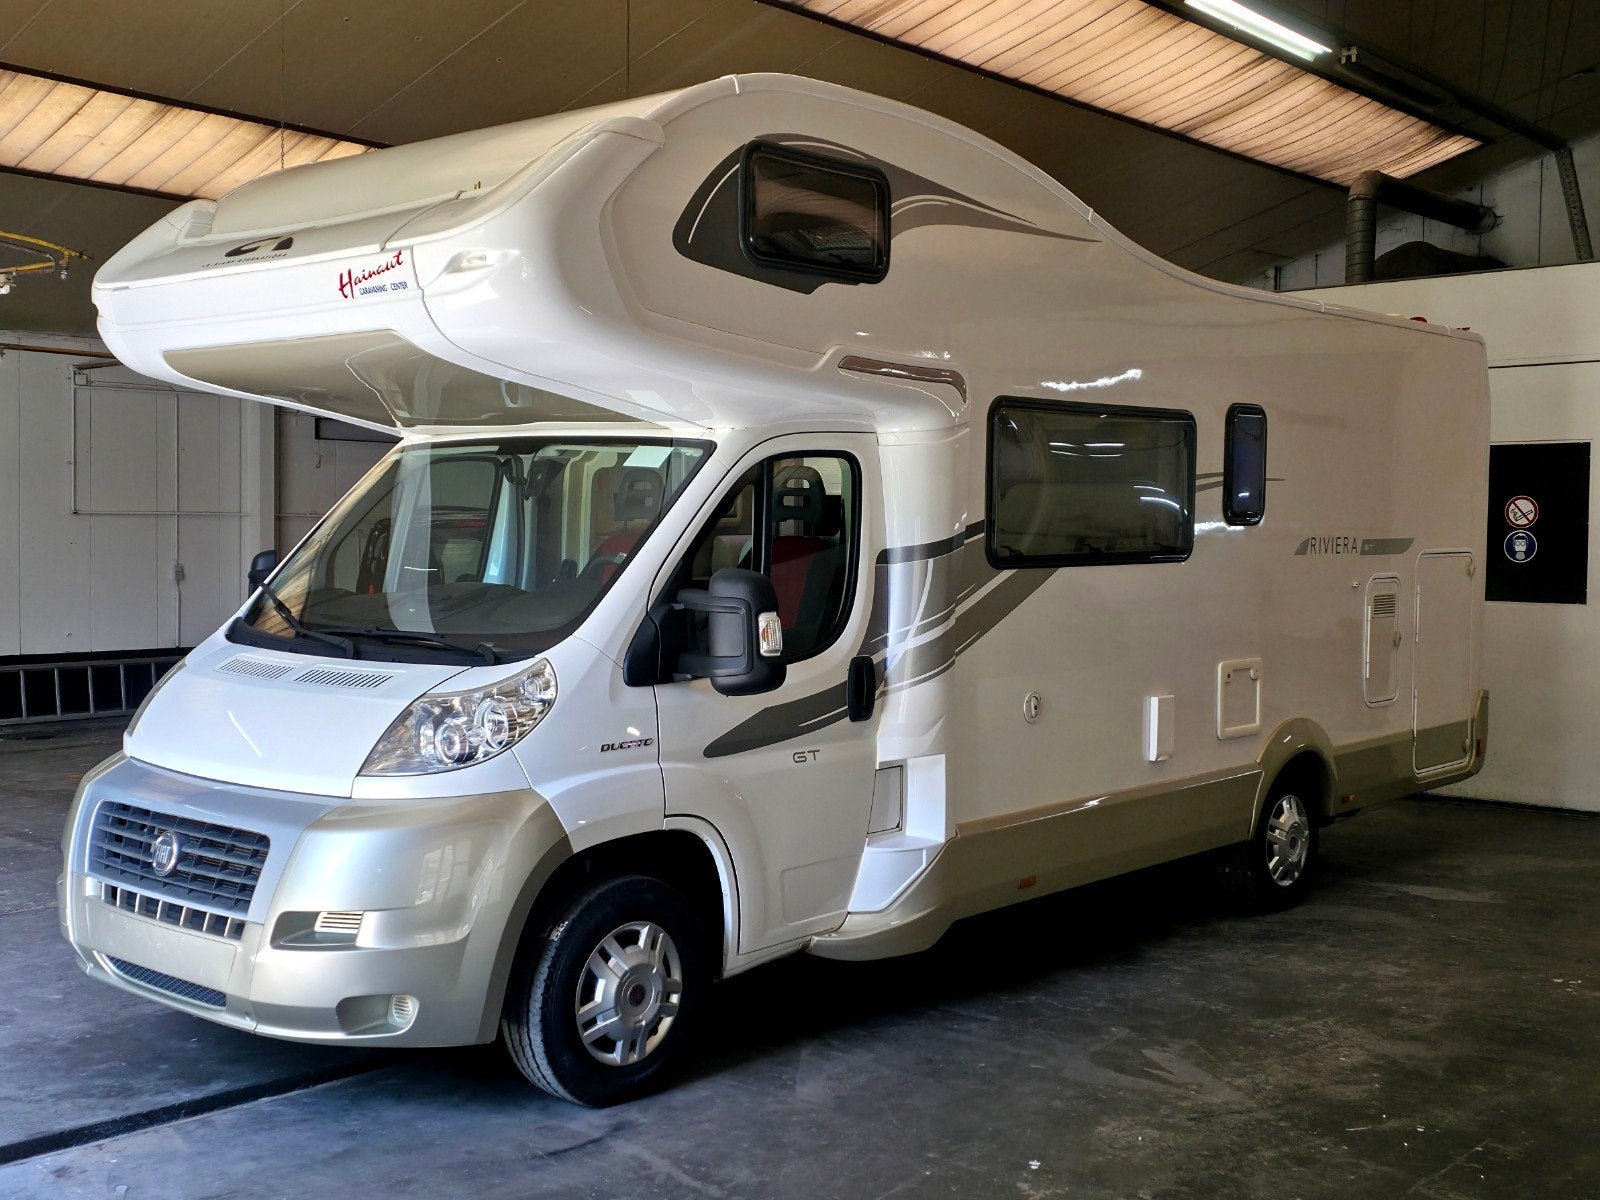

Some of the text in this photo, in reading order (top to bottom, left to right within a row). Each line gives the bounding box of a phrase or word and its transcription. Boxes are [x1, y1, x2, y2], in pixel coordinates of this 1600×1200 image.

[338, 249, 404, 299] Hainaut
[390, 281, 409, 292] CENTER
[1310, 536, 1358, 555] RIVIERA
[792, 749, 820, 764] GT
